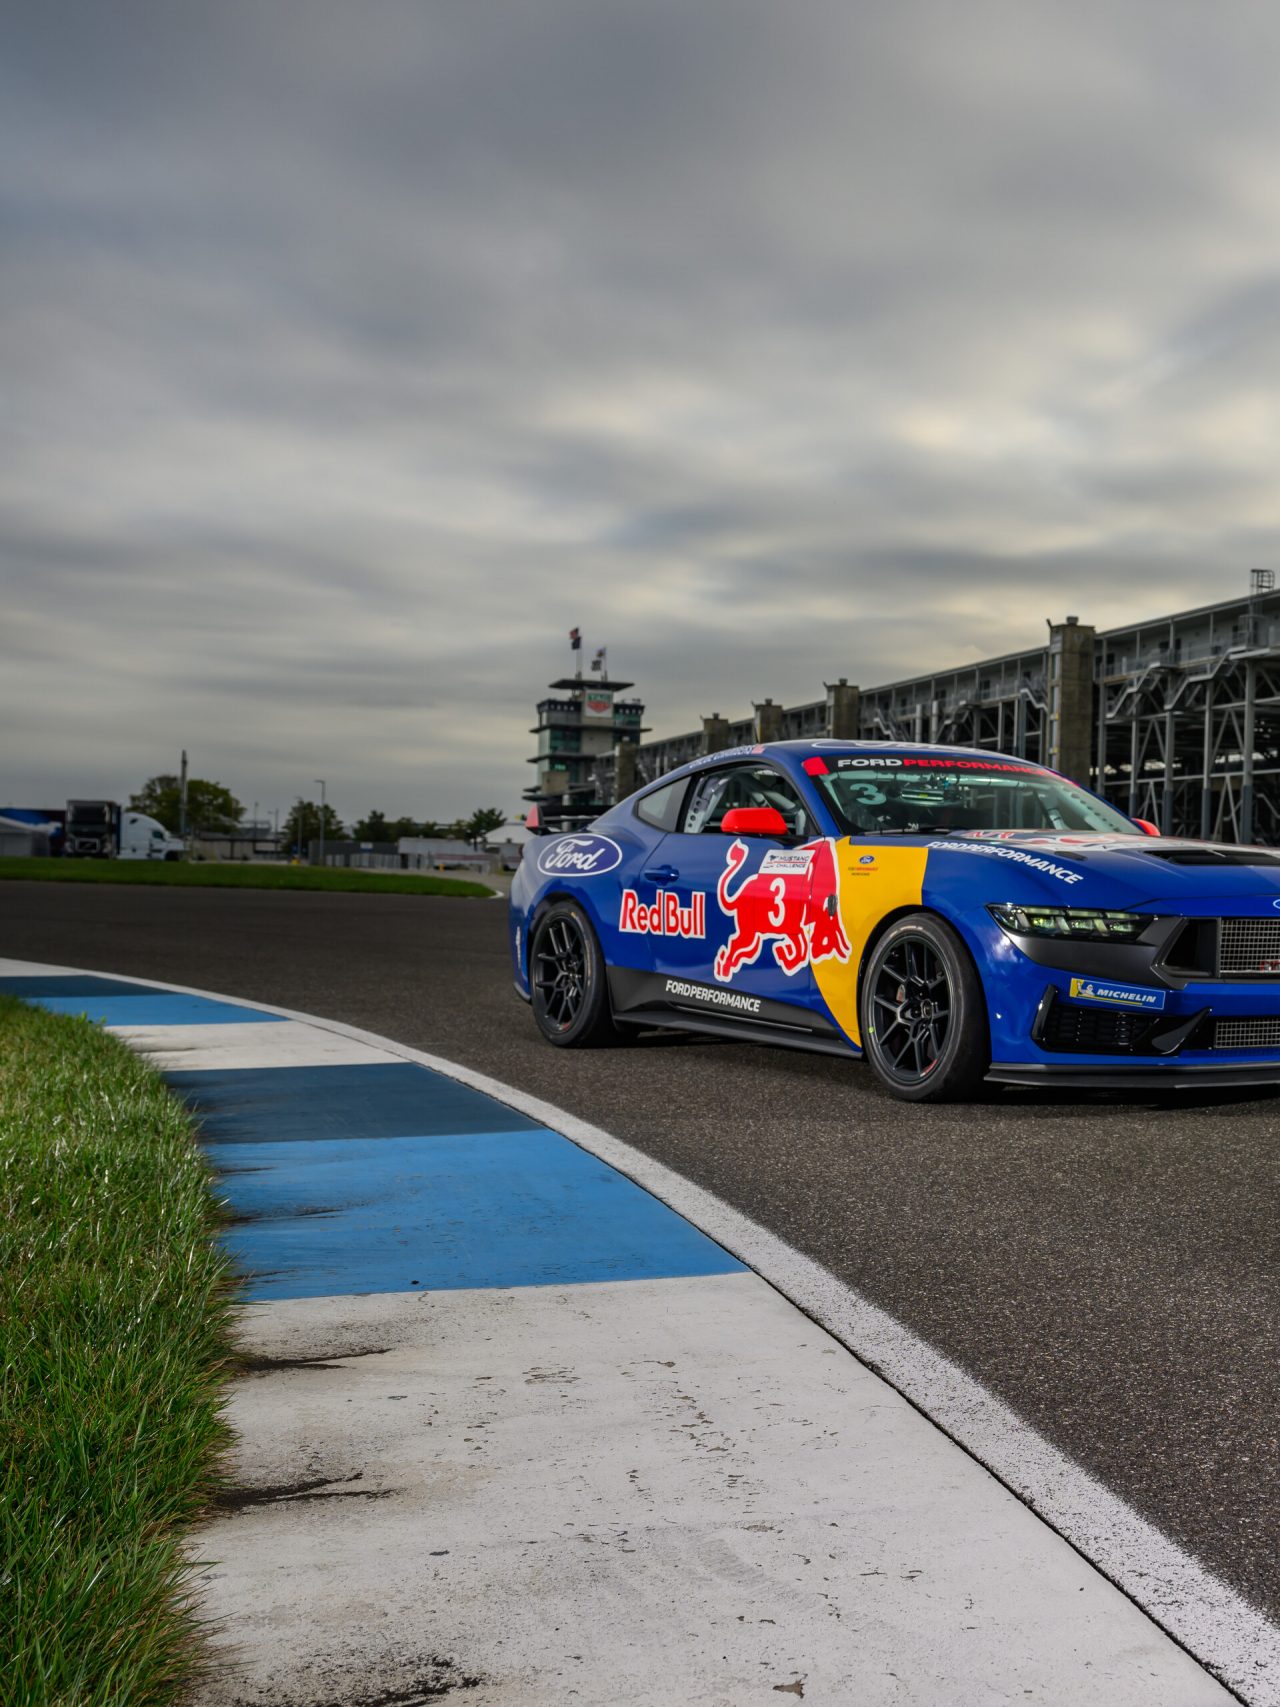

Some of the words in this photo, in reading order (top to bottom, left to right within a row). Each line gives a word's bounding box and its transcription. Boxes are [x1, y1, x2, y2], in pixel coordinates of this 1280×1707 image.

[850, 783, 887, 805] 3
[545, 839, 606, 871] Ford
[768, 877, 786, 927] 3
[1097, 988, 1157, 1003] MICHELIN
